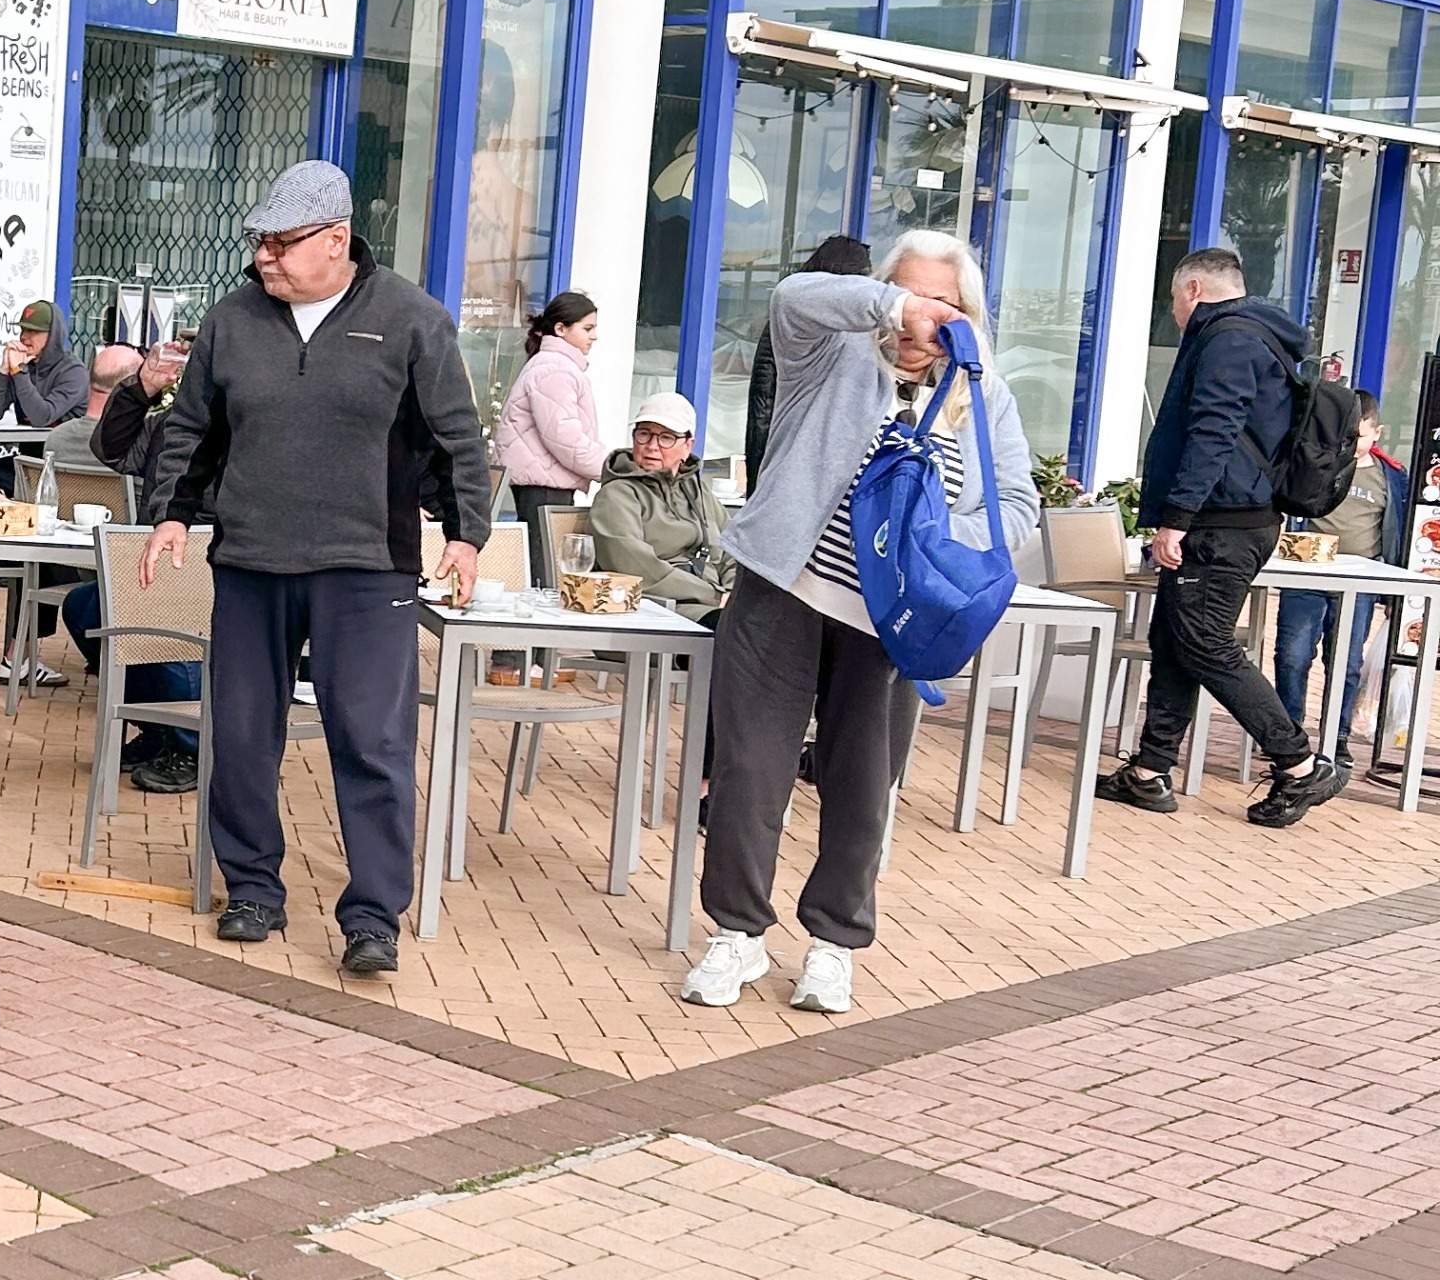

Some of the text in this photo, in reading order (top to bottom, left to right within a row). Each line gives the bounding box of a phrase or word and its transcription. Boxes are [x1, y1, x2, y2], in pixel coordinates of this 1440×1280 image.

[219, 7, 241, 22] HAIR
[254, 13, 289, 28] BEAUTY
[1, 77, 42, 98] BEANS
